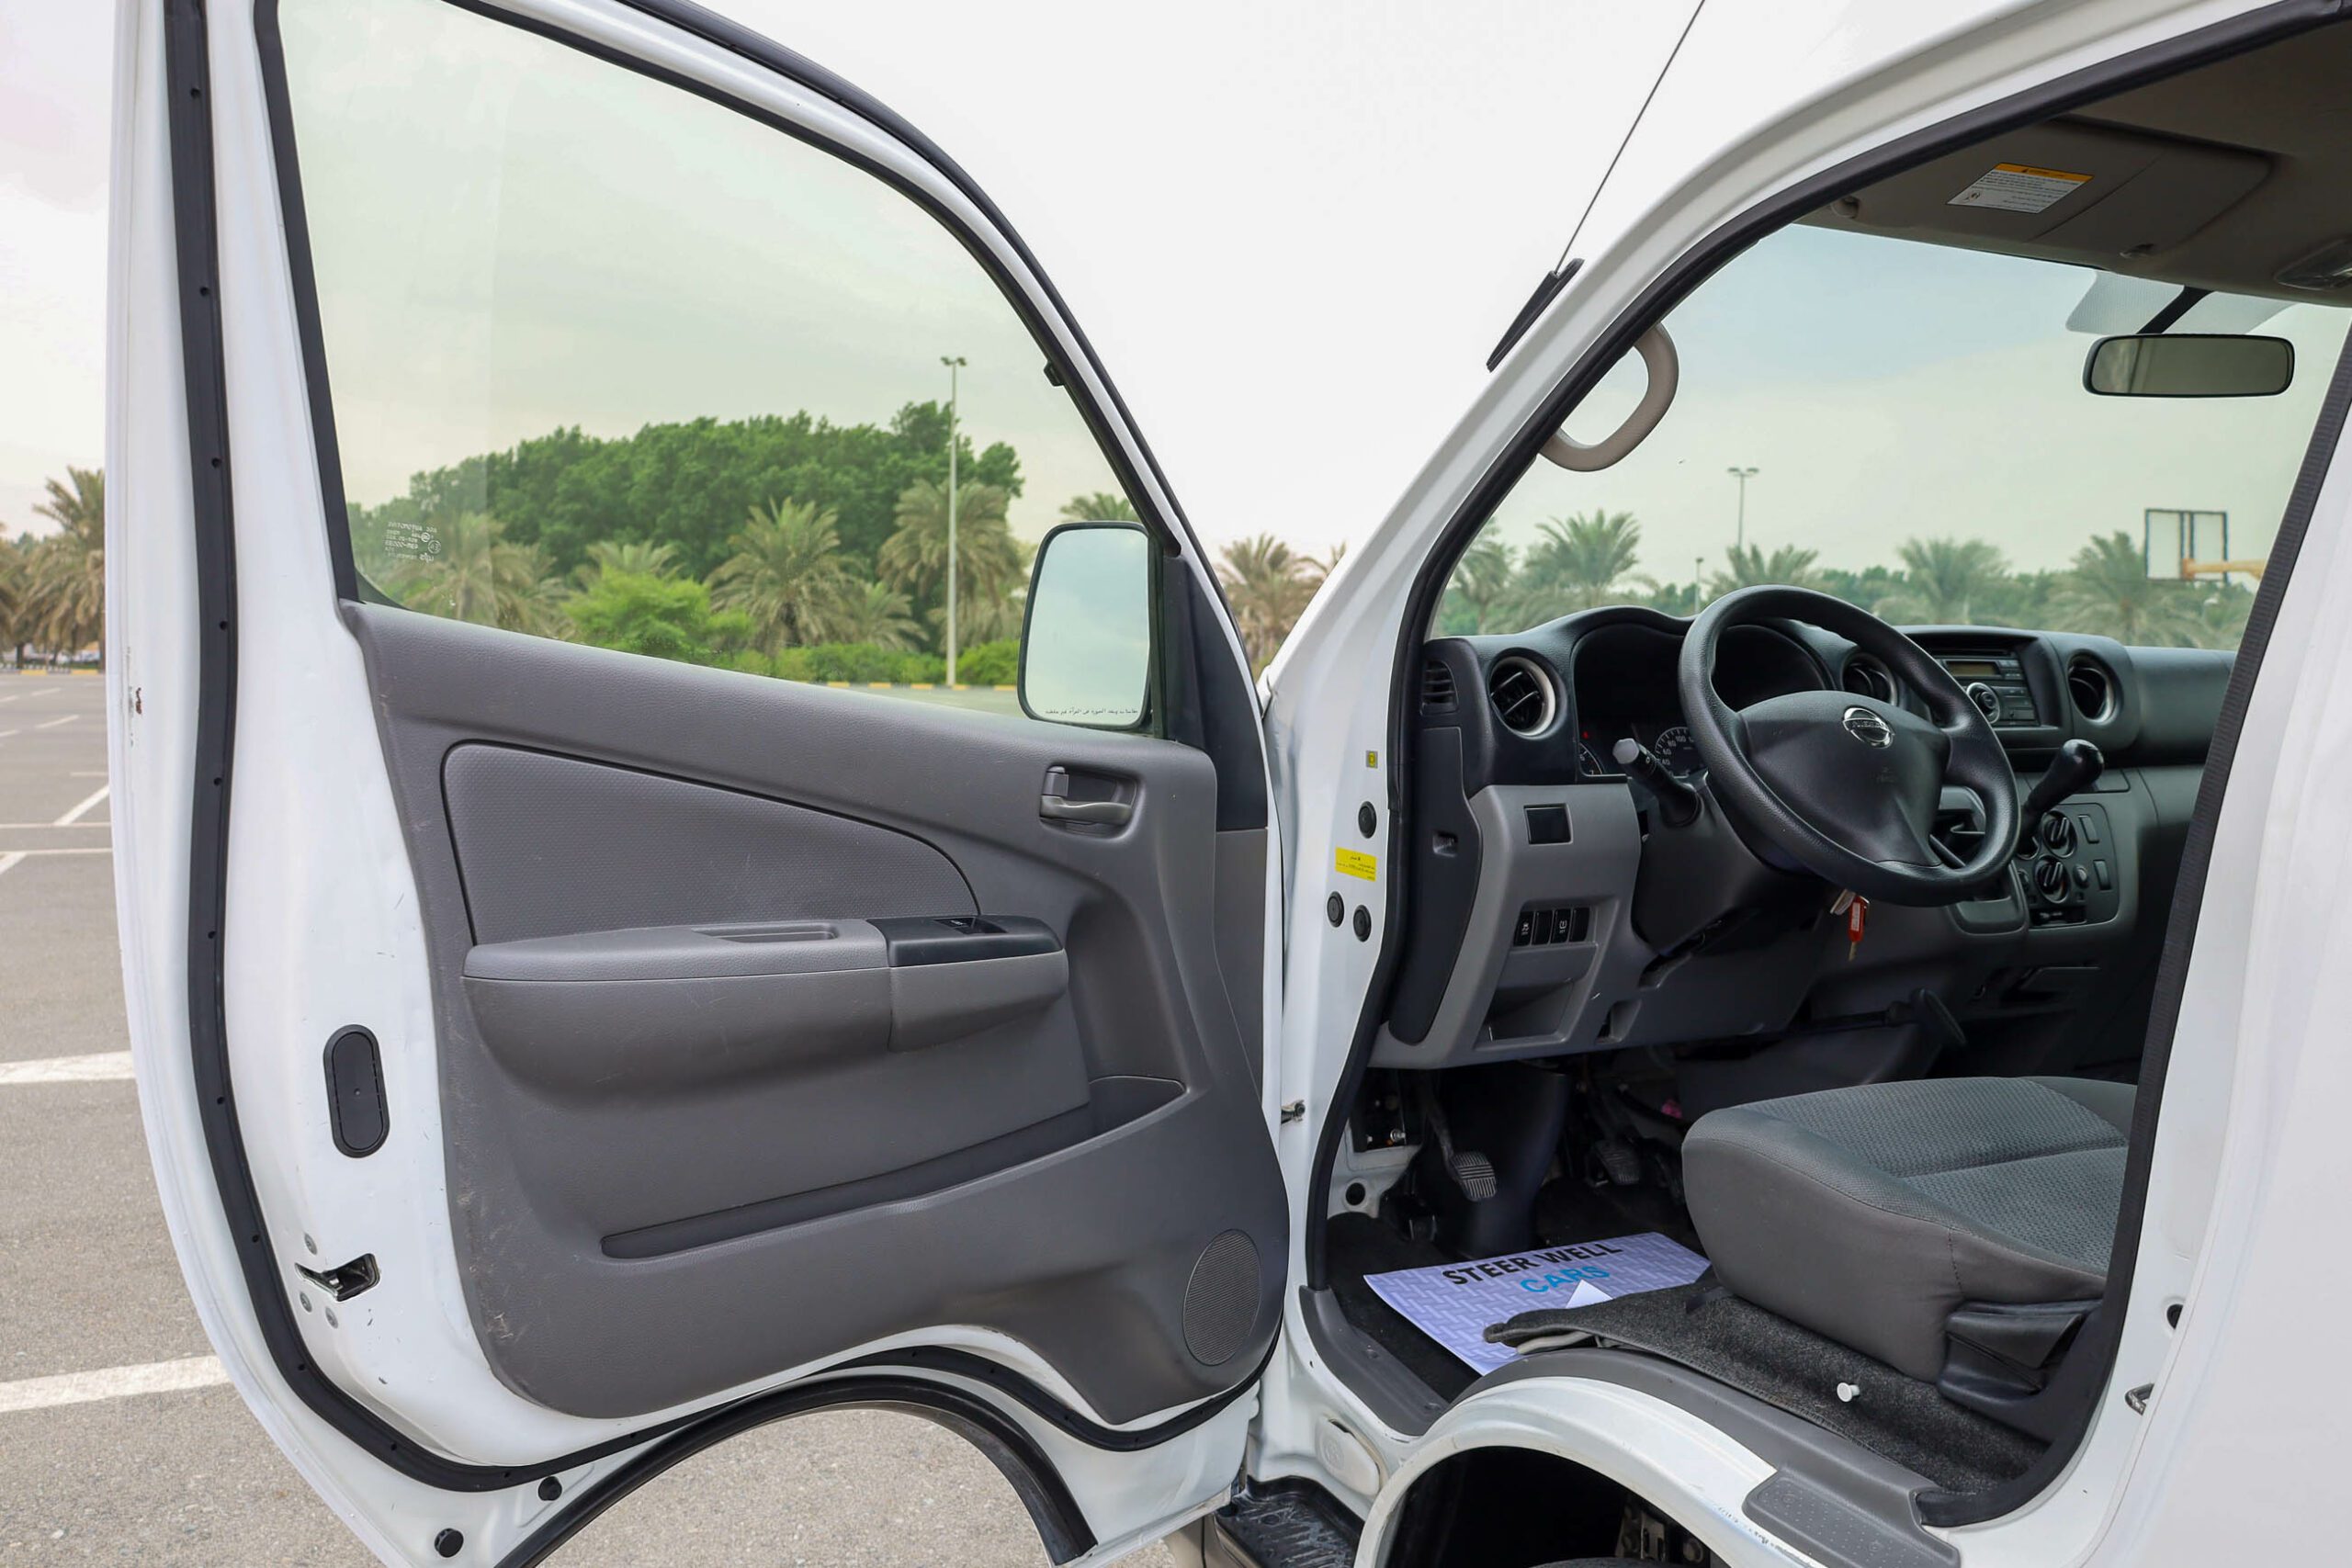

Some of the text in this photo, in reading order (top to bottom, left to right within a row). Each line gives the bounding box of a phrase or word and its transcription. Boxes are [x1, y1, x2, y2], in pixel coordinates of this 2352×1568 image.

[1442, 1243, 1623, 1284] STEER WELL
[1520, 1266, 1611, 1292] CARS
